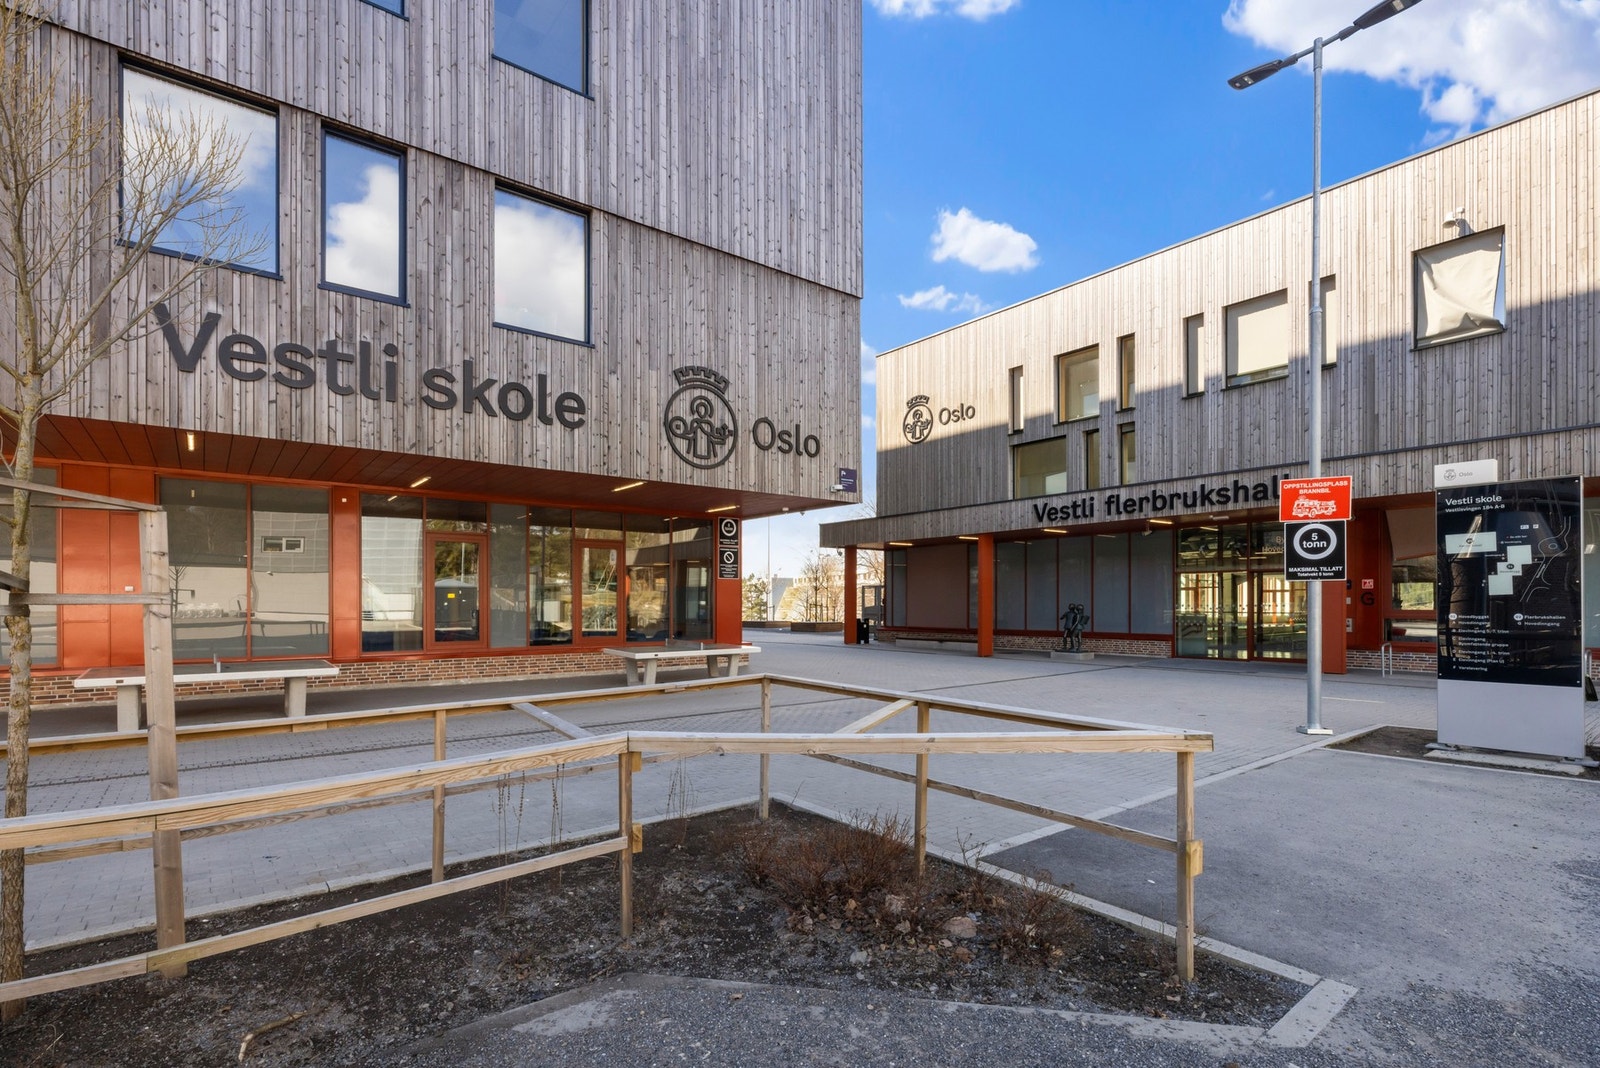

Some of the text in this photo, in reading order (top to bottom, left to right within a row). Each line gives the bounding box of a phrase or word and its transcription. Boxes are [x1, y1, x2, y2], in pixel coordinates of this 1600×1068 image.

[152, 302, 586, 429] Vestli skole
[939, 403, 976, 425] Oslo
[753, 417, 820, 458] Oslo
[1283, 480, 1349, 490] OPPSTILLINGSPLASS
[1299, 487, 1331, 495] BRANNBIL
[1033, 473, 1289, 523] Vestli flerbrukshal
[1445, 494, 1502, 506] Vestli skole
[1311, 532, 1318, 541] 5
[1302, 540, 1327, 549] tonn
[1361, 591, 1375, 606] G
